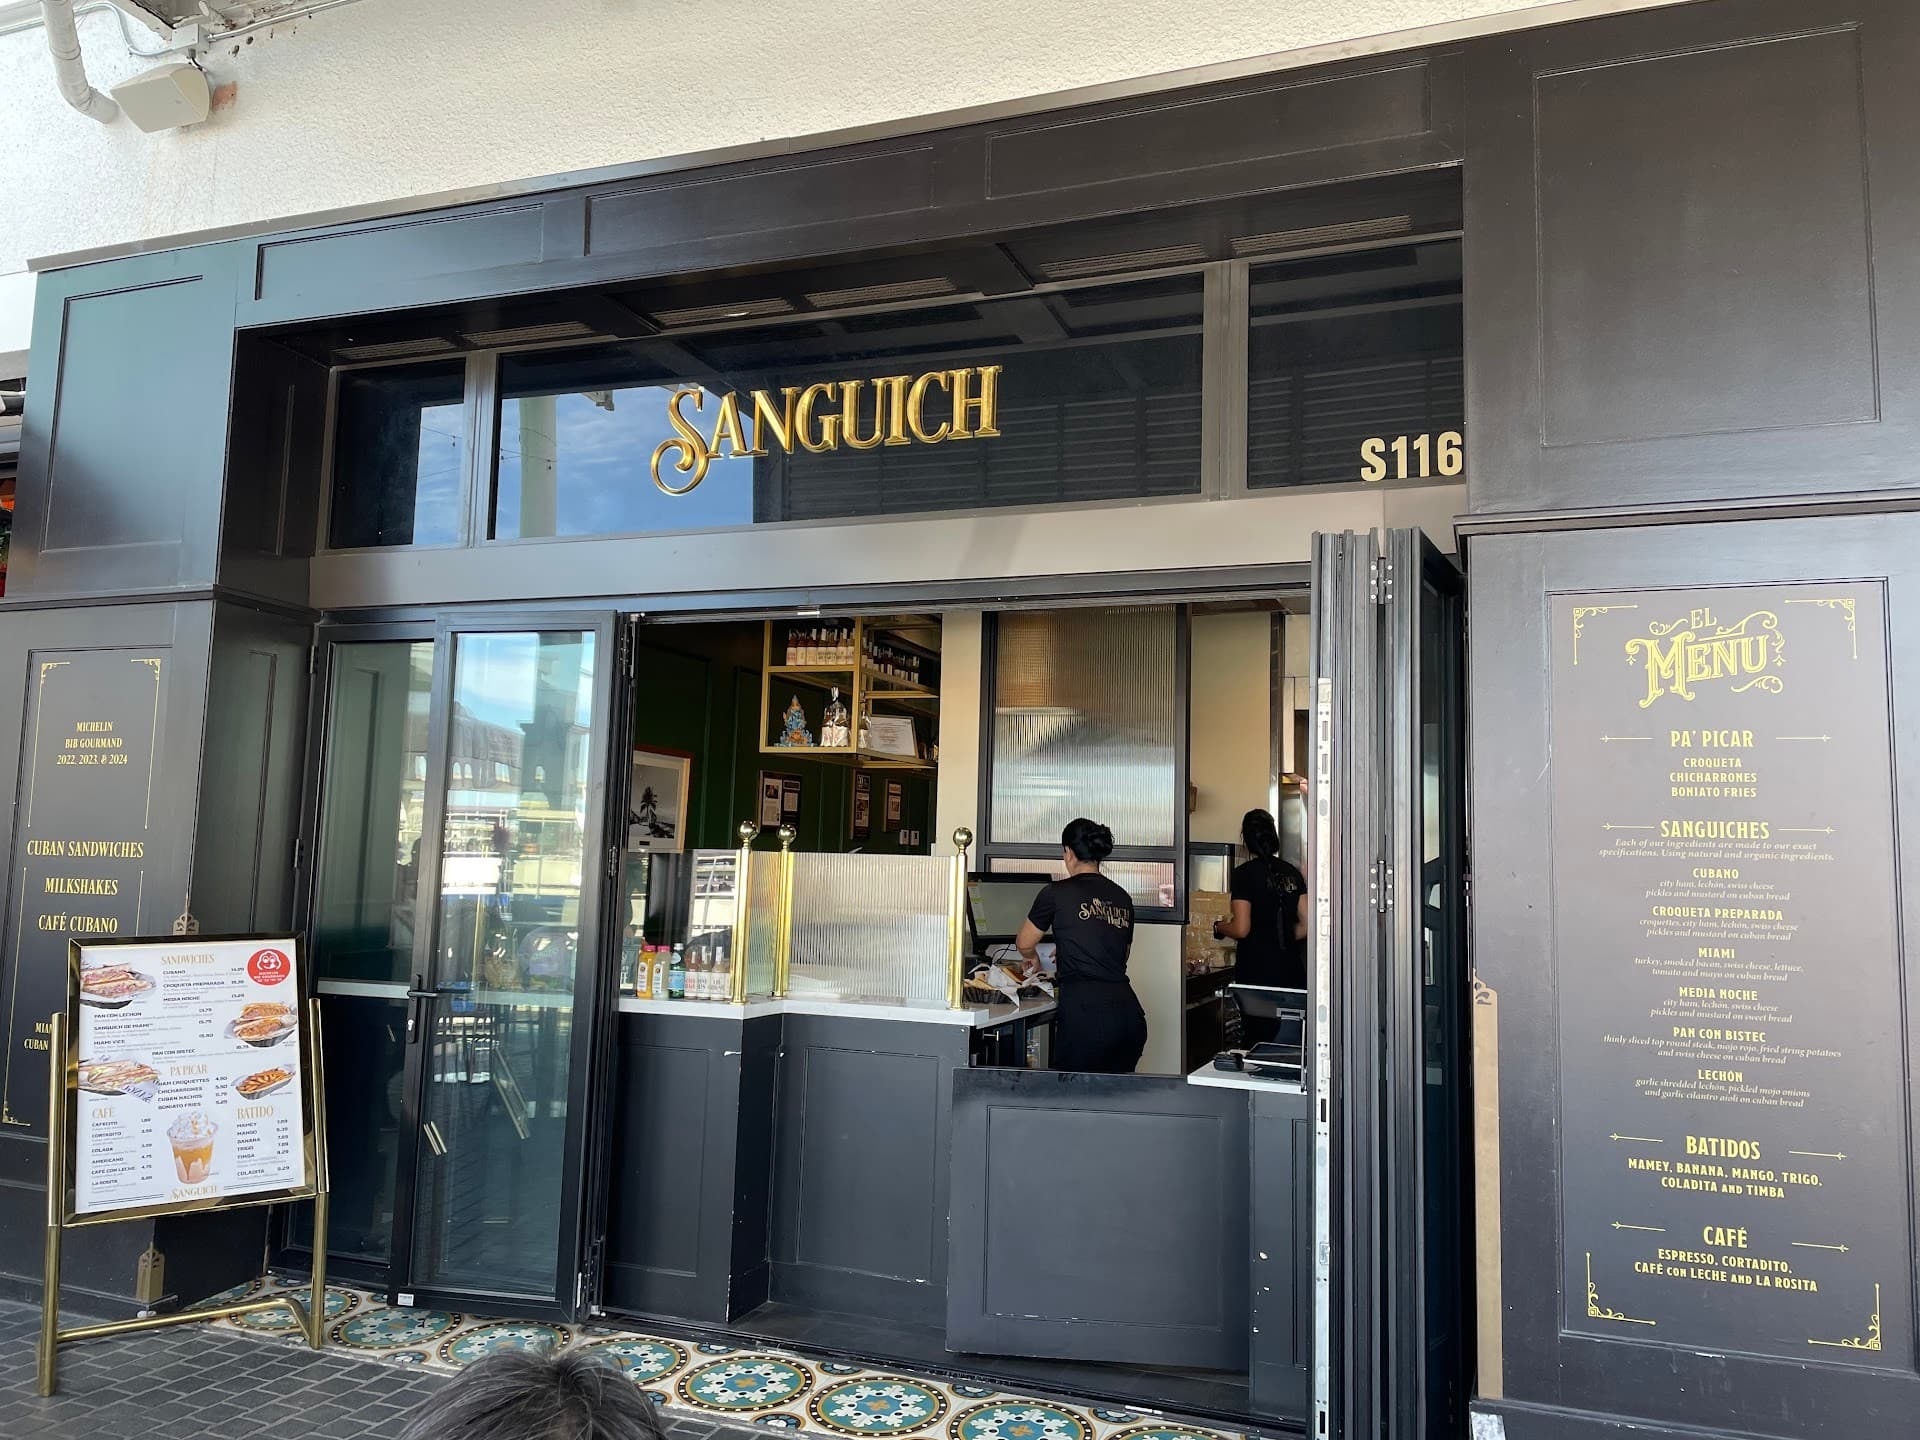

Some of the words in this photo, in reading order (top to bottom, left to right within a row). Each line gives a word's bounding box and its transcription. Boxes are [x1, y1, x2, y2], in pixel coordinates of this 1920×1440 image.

[650, 364, 1004, 498] SANGUICH
[1360, 430, 1464, 482] S116
[1689, 606, 1718, 630] EL
[1624, 630, 1770, 709] MENU
[76, 721, 113, 732] MICHELIN
[65, 738, 78, 748] BIB
[80, 737, 122, 748] GOURMAND
[1670, 730, 1696, 748] PA'
[1702, 730, 1753, 748] PICAR
[100, 754, 107, 764] &
[108, 754, 128, 765] 2024
[1683, 758, 1742, 768] CROQUETA
[1669, 772, 1757, 783] CHICHARRONES
[1671, 786, 1720, 797] BONIATO
[1724, 787, 1756, 798] FRIES
[1660, 820, 1770, 839] SANGUICHES
[27, 840, 65, 856] CUBAN
[68, 841, 144, 858] SANDWICHES
[1615, 838, 1637, 847] Each
[1638, 838, 1648, 849] of
[1666, 839, 1716, 849] ingredients
[1735, 840, 1761, 849] made
[1762, 842, 1772, 850] to
[1599, 848, 1659, 858] specifications.
[1661, 849, 1686, 859] Using
[1688, 850, 1722, 858] natural
[1724, 850, 1742, 859] and
[1744, 852, 1779, 861] organic
[1780, 852, 1834, 861] ingredients.
[1692, 868, 1739, 879] CUBANO
[44, 877, 118, 895] MILKSHAKES
[1659, 880, 1675, 888] city
[1675, 880, 1696, 888] ham,
[1748, 881, 1774, 890] cheese
[1646, 890, 1672, 899] pickles
[1673, 890, 1690, 898] and
[1691, 890, 1726, 899] mustard
[1739, 891, 1764, 900] cuban
[1766, 892, 1790, 901] bread
[1652, 905, 1711, 918] CROQUETA
[1714, 908, 1783, 920] PREPARADA
[38, 911, 67, 931] CAFÉ
[70, 916, 118, 934] CUBANO
[1639, 919, 1682, 928] croquettes,
[1682, 920, 1698, 929] city
[1698, 919, 1719, 928] ham,
[1772, 922, 1798, 931] cheese
[1646, 928, 1673, 938] pickles
[1692, 930, 1727, 938] mustard
[1740, 931, 1766, 940] cuban
[1766, 932, 1792, 941] bread
[162, 953, 215, 966] SANDWICHES
[1698, 947, 1735, 959] MIAMI
[1634, 957, 1662, 966] turkey,
[1664, 959, 1694, 967] smoked
[1652, 968, 1681, 976] tomato
[1682, 969, 1699, 977] and
[1700, 971, 1723, 979] mayo
[1736, 971, 1762, 980] cuban
[1763, 972, 1788, 981] bread
[1679, 986, 1716, 998] MEDIA
[1720, 989, 1758, 1001] NOCHE
[1663, 999, 1678, 1009] city
[1679, 999, 1700, 1008] ham,
[1752, 1003, 1778, 1012] cheese
[1650, 1008, 1678, 1018] pickles
[1696, 1011, 1732, 1020] mustard
[1744, 1014, 1767, 1022] sweet
[1768, 1013, 1793, 1023] bread
[1673, 1026, 1696, 1038] PAN
[1699, 1028, 1721, 1040] CON
[1725, 1030, 1766, 1043] BISTEC
[23, 1038, 49, 1051] CUBAN
[1603, 1034, 1627, 1044] thinly
[1628, 1036, 1651, 1045] sliced
[1651, 1038, 1665, 1048] top
[1666, 1040, 1691, 1048] round
[1692, 1041, 1716, 1050] steak,
[1716, 1044, 1738, 1052] mojo
[1759, 1044, 1780, 1054] fried
[1781, 1047, 1805, 1056] string
[1806, 1049, 1842, 1057] potatoes
[1657, 1048, 1674, 1057] and
[1696, 1050, 1722, 1060] cheese
[1735, 1054, 1760, 1062] cuban
[1762, 1054, 1787, 1064] bread
[1635, 1078, 1658, 1088] garlic
[1660, 1079, 1697, 1089] shredded
[1728, 1084, 1758, 1094] pickled
[1759, 1088, 1781, 1096] mojo
[1782, 1089, 1810, 1097] onions
[1644, 1089, 1661, 1097] and
[1661, 1090, 1684, 1099] garlic
[1686, 1091, 1718, 1101] cilantro
[1720, 1094, 1738, 1103] aioli
[1752, 1096, 1778, 1105] cuban
[1779, 1097, 1804, 1107] bread
[1686, 1135, 1760, 1160] BATIDOS
[1628, 1158, 1673, 1173] MAMEY,
[1676, 1162, 1728, 1178] BANANA,
[1781, 1172, 1822, 1186] TRIGO,
[1661, 1176, 1718, 1192] COLADITA
[1721, 1184, 1743, 1194] AND
[1746, 1184, 1785, 1198] TIMBA
[1703, 1226, 1748, 1248] CAFÉ
[1658, 1248, 1718, 1266] ESPRESSO,
[1722, 1255, 1792, 1274] CORTADITO,
[1634, 1260, 1664, 1275] CAFÉ
[1690, 1267, 1727, 1282] LECHE
[1730, 1274, 1752, 1285] AND
[1756, 1274, 1771, 1287] LA
[1774, 1276, 1818, 1292] ROSITA
